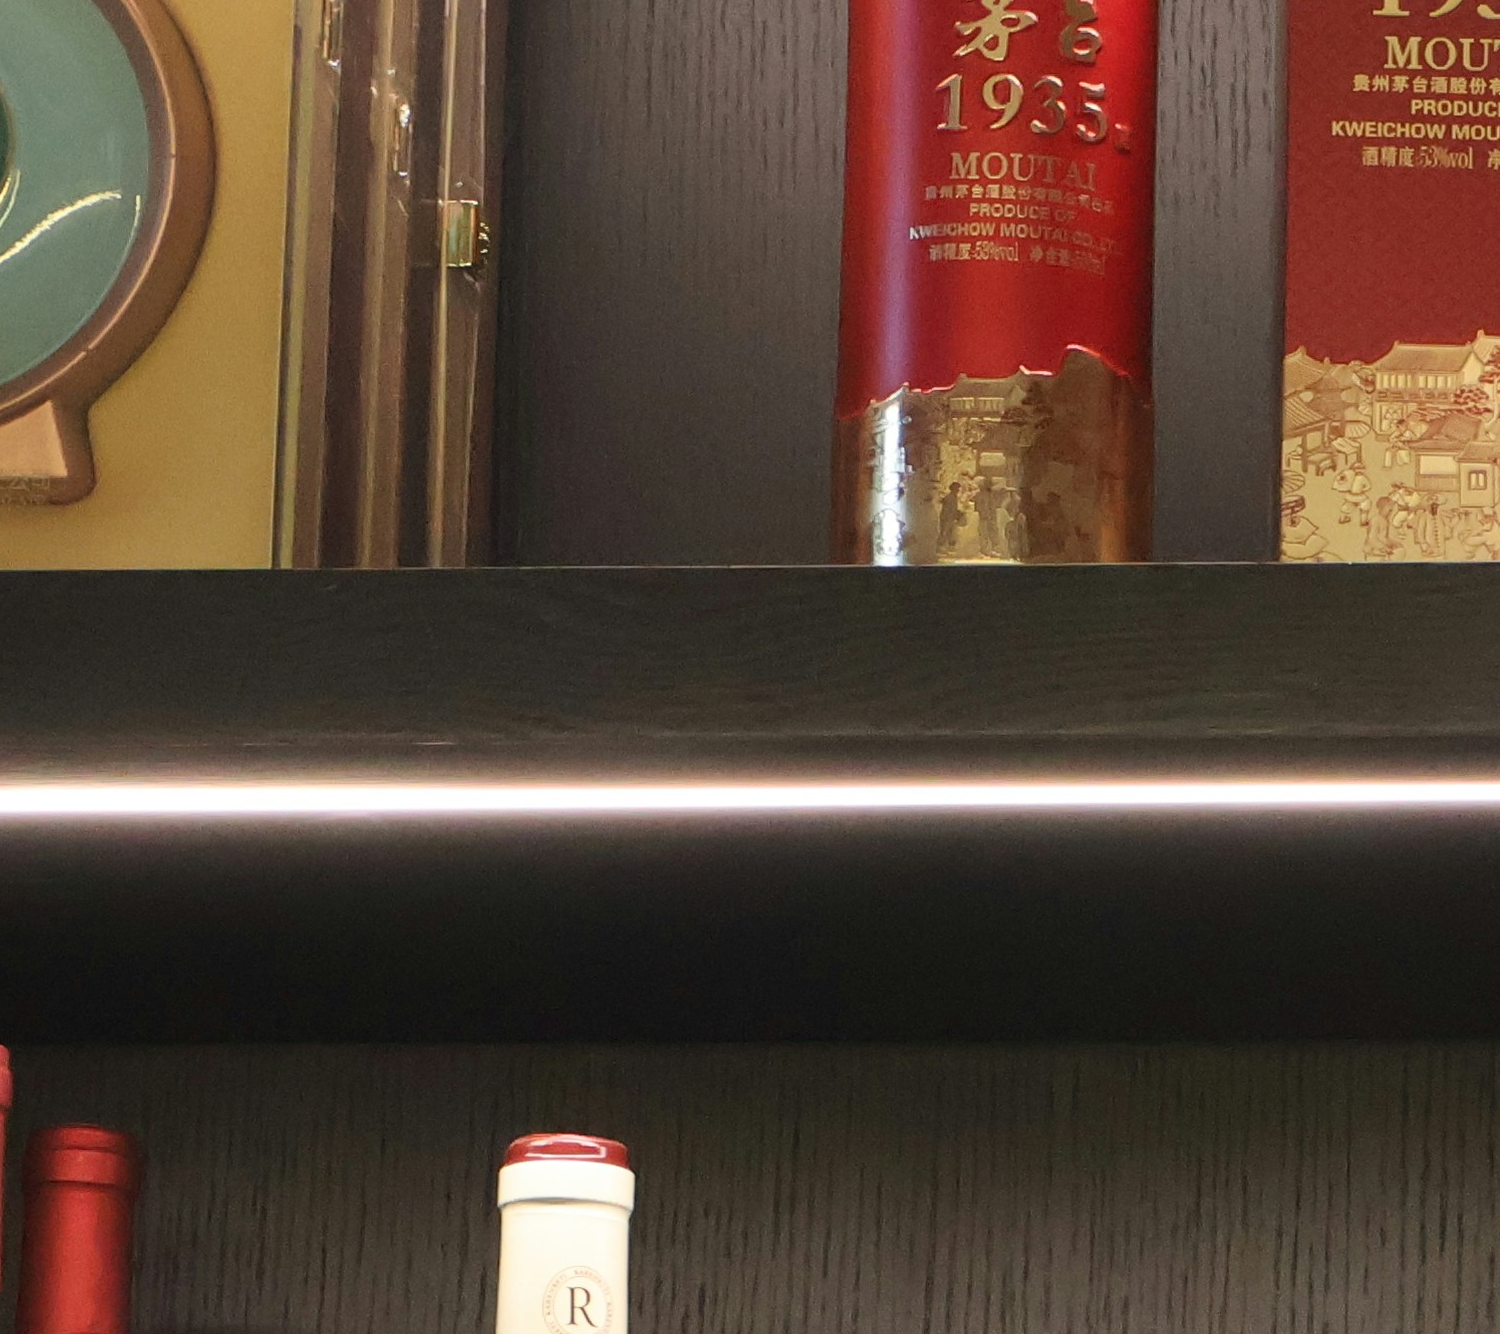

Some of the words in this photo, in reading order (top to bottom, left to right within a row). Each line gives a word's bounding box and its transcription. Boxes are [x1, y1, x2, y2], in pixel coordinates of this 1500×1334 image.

[935, 73, 1109, 144] 1935
[1331, 121, 1444, 139] KWEICHOW
[950, 152, 1095, 190] MOUTAI
[969, 203, 1048, 219] PRODUCE
[910, 225, 995, 239] KWEICHOW
[567, 1287, 597, 1328] R
